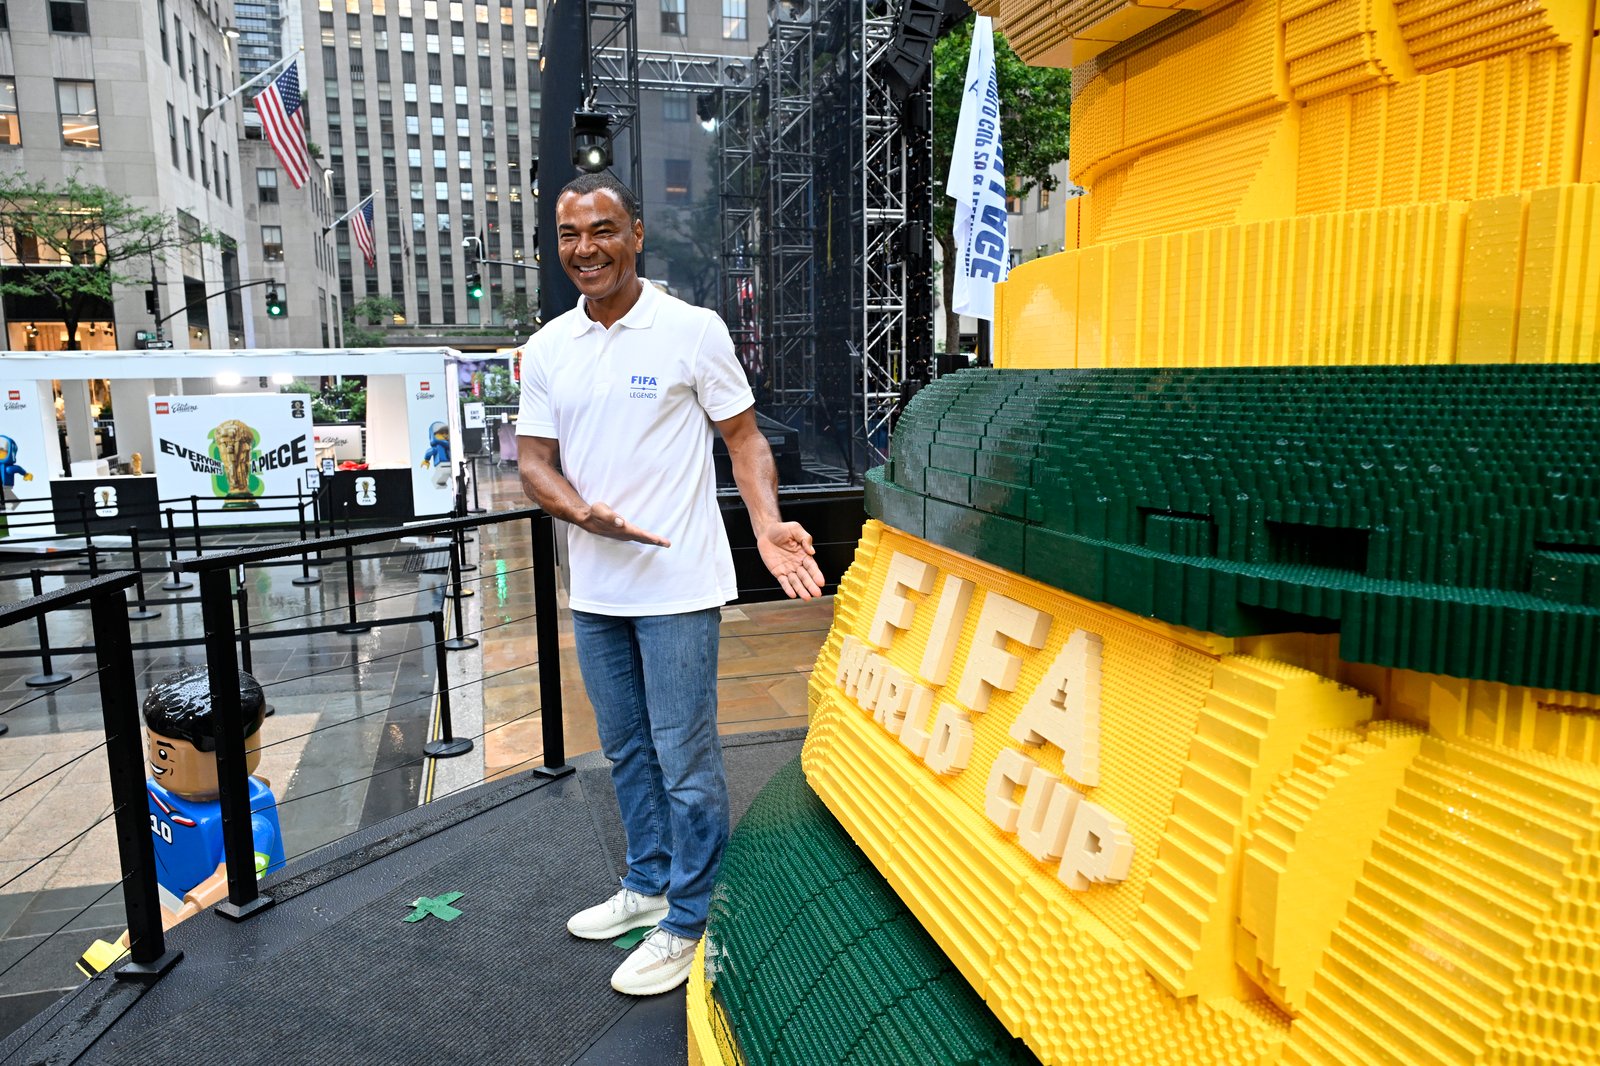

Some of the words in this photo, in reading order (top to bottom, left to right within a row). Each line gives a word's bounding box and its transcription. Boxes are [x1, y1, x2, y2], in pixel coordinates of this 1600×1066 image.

[631, 376, 657, 386] FIFA
[159, 438, 222, 467] EVERYONE
[251, 459, 257, 473] A
[259, 434, 308, 472] PIECE
[190, 461, 223, 475] WANTS
[868, 551, 1104, 788] FIFA
[836, 634, 974, 776] WORLD
[984, 747, 1136, 892] CUP
[150, 814, 172, 844] 10
